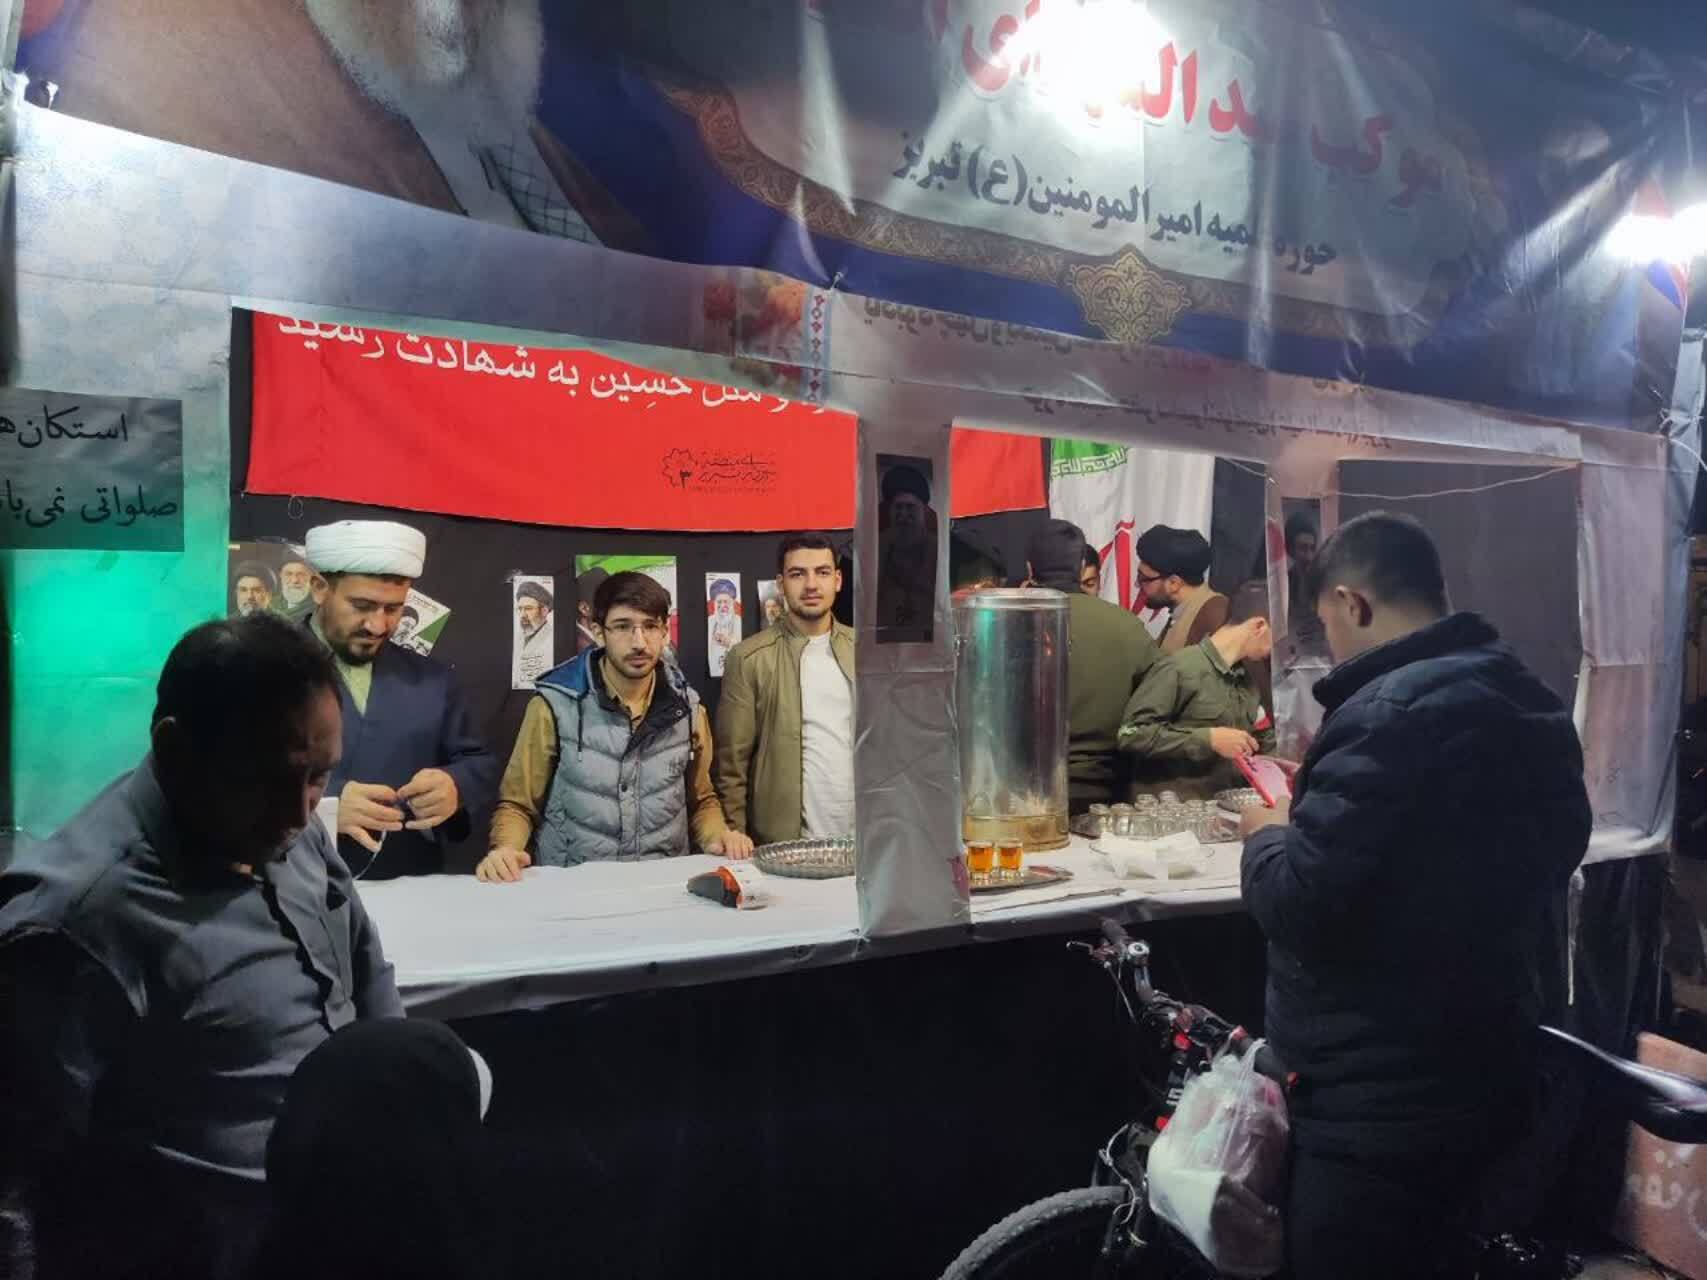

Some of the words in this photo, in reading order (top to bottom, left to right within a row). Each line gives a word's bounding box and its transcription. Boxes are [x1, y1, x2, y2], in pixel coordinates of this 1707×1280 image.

[893, 130, 963, 191] تبریز
[278, 317, 385, 359] رسید
[397, 332, 536, 379] شهادت
[548, 359, 580, 397] به
[80, 485, 177, 527] صلواتی
